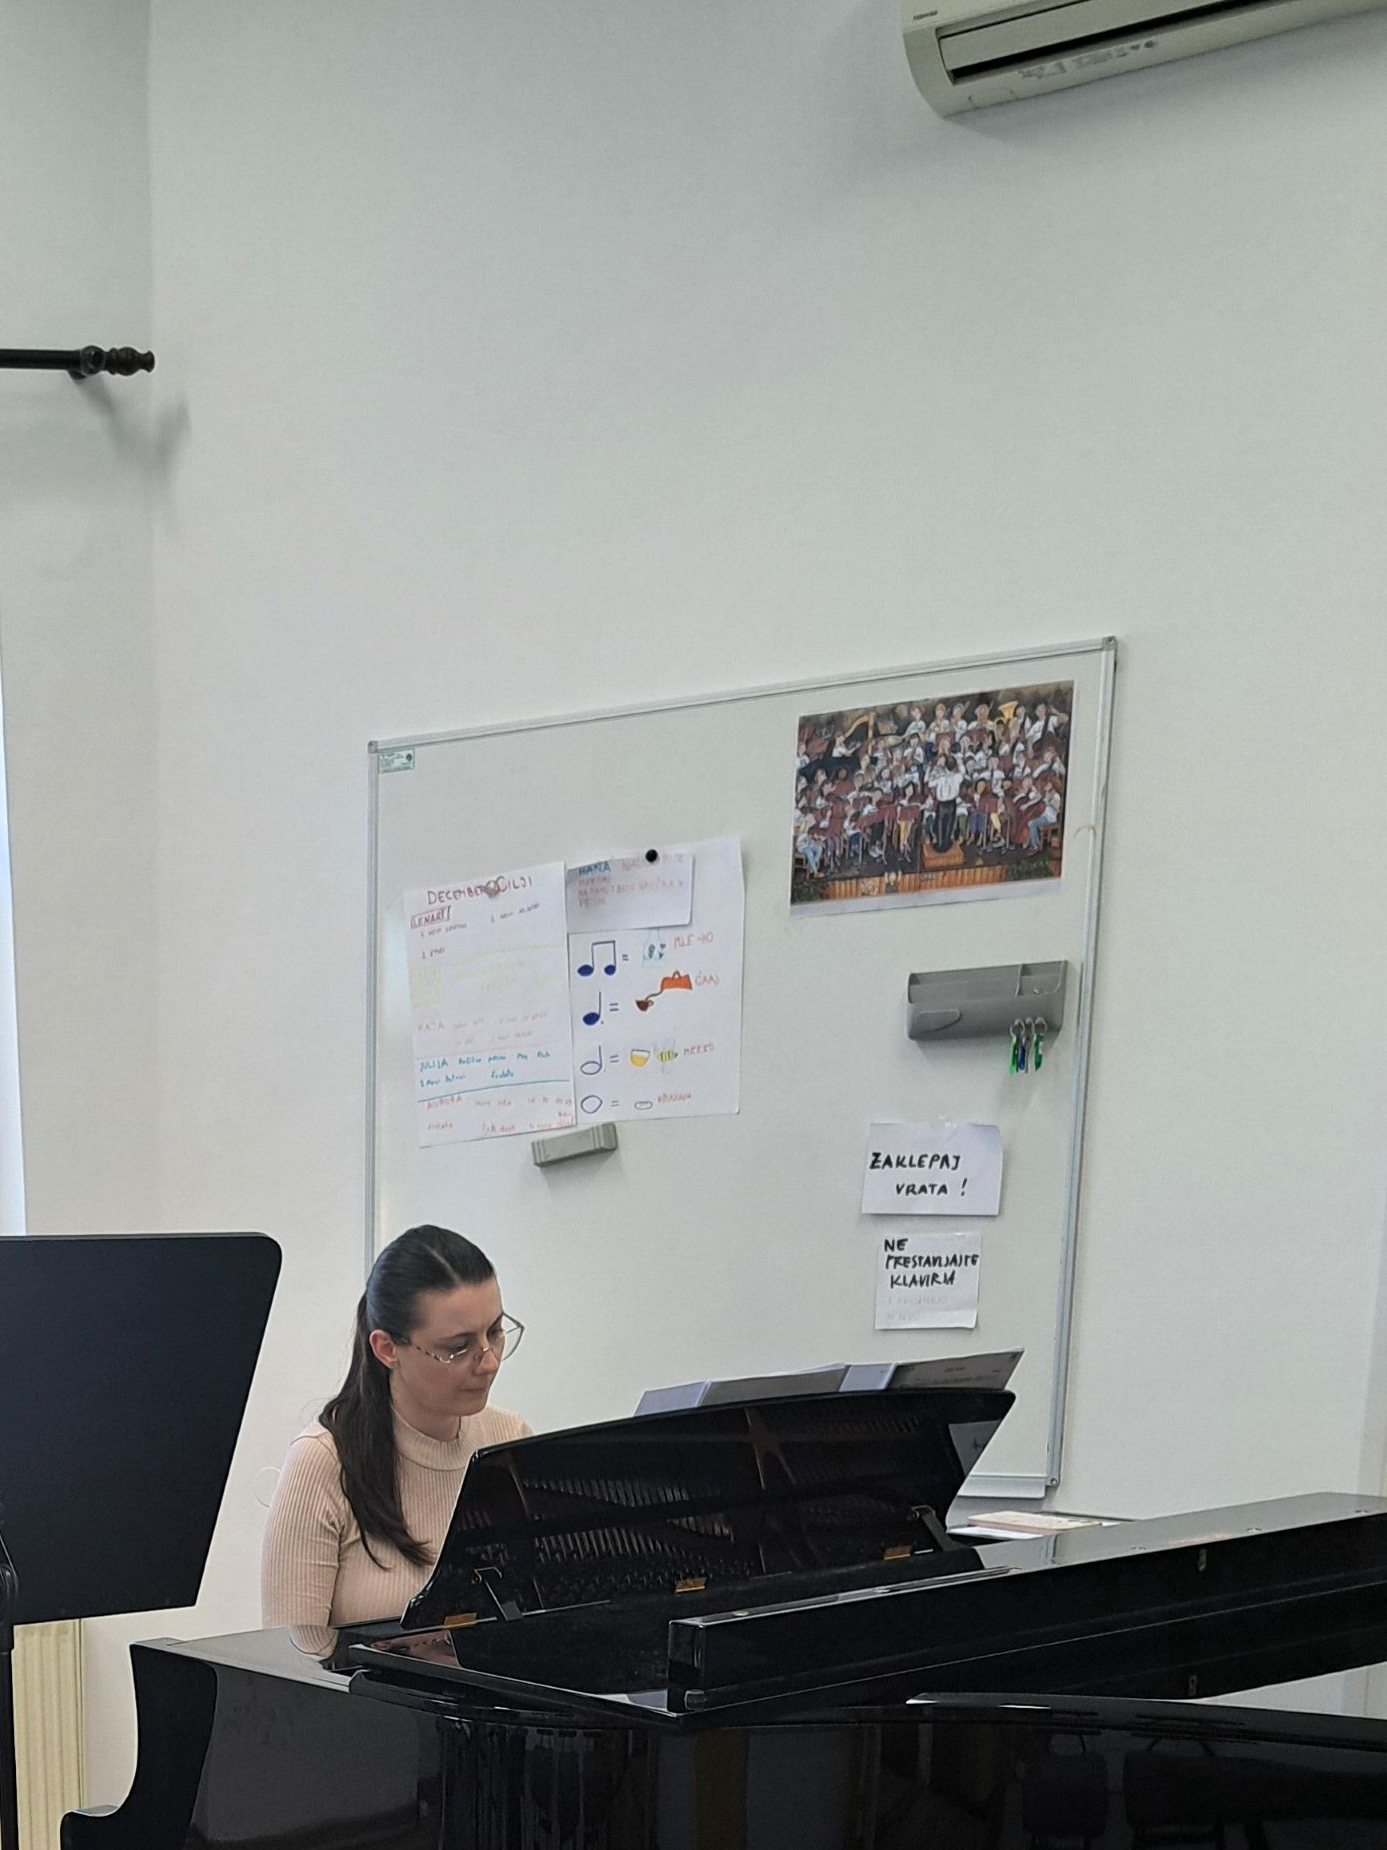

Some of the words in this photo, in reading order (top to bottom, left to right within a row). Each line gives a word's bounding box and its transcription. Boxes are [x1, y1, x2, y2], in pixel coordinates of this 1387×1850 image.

[869, 1151, 961, 1171] ZAKLEPAJ
[895, 1182, 948, 1197] VRATA
[884, 1238, 909, 1252] NE
